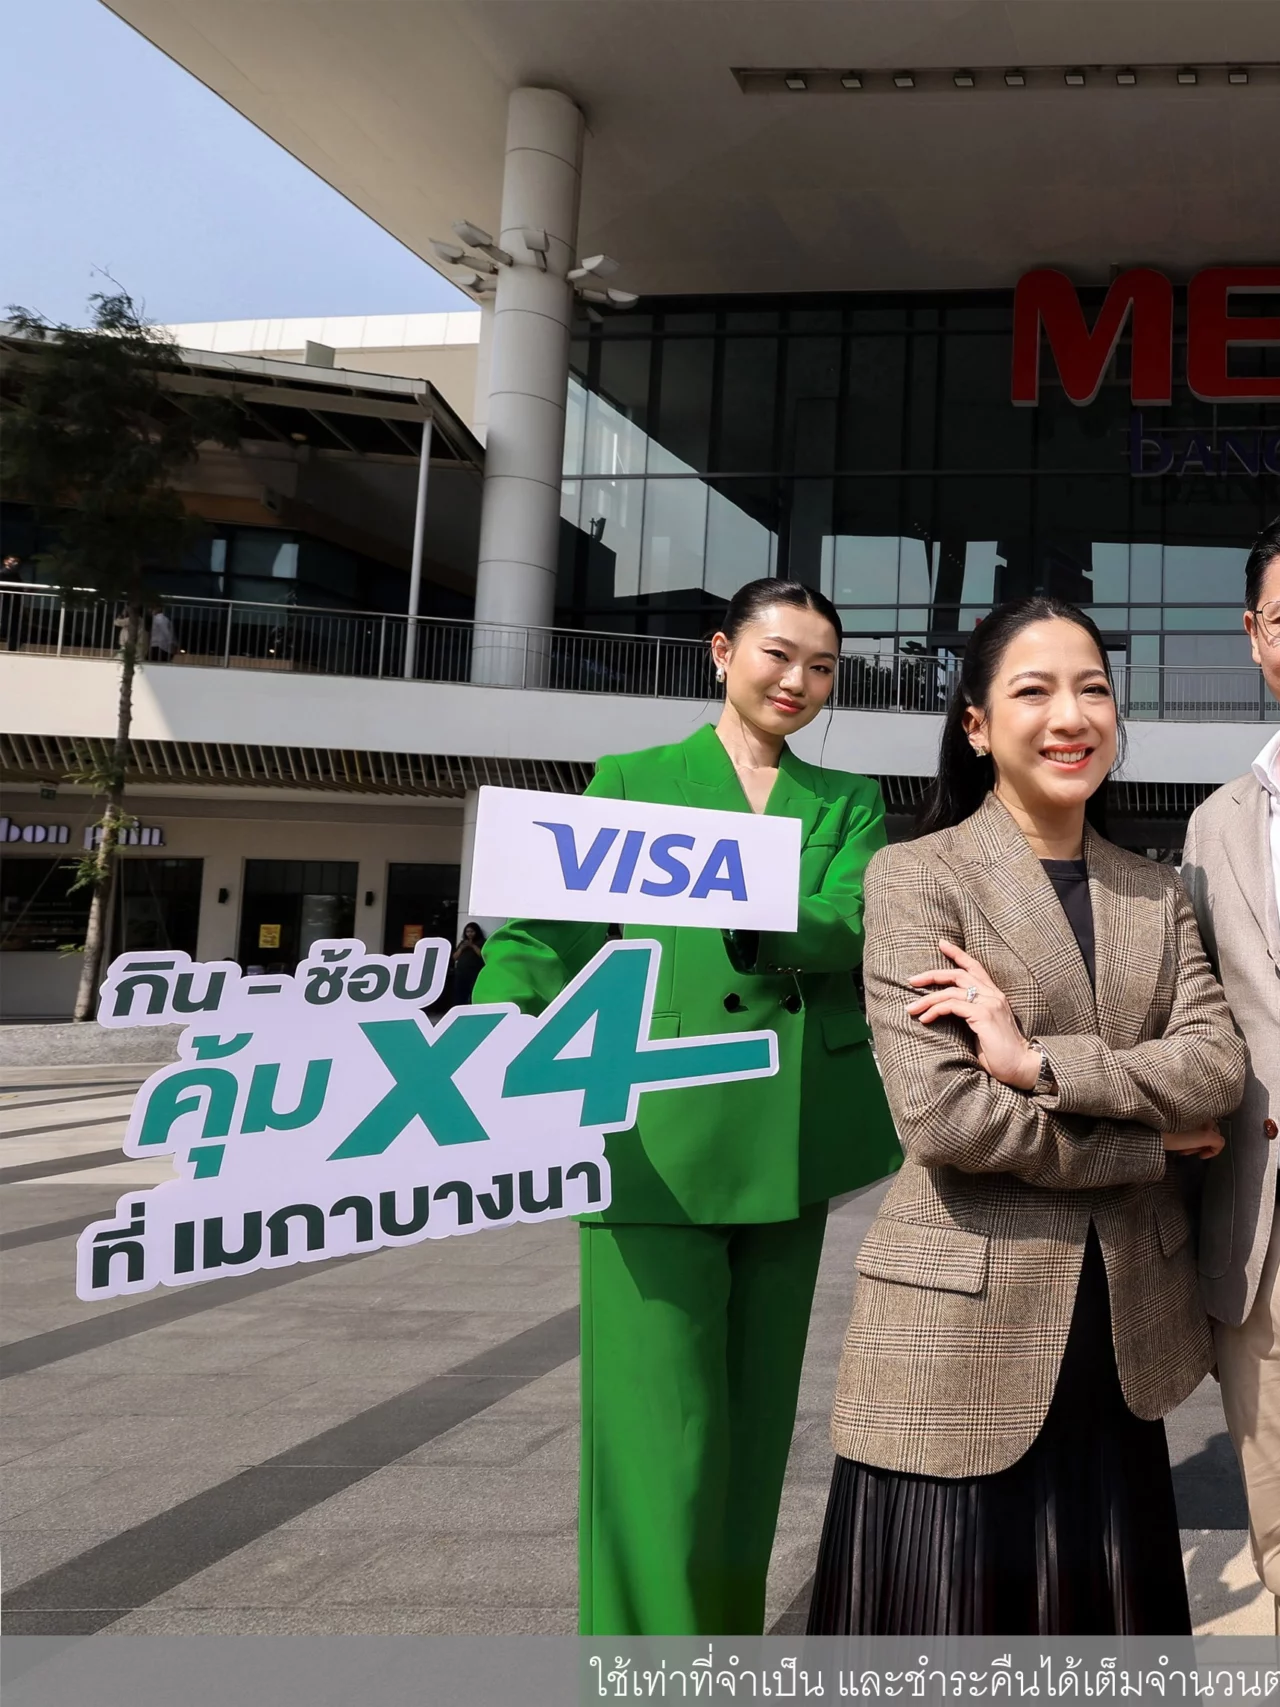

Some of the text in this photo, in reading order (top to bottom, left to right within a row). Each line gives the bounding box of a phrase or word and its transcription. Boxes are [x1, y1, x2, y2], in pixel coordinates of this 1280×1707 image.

[533, 820, 748, 902] VISA
[113, 960, 226, 1017] กิน
[303, 947, 439, 1006] ช้อป
[137, 1032, 333, 1180] คุ้ม
[91, 1160, 602, 1290] ที่ เมกาบางนา
